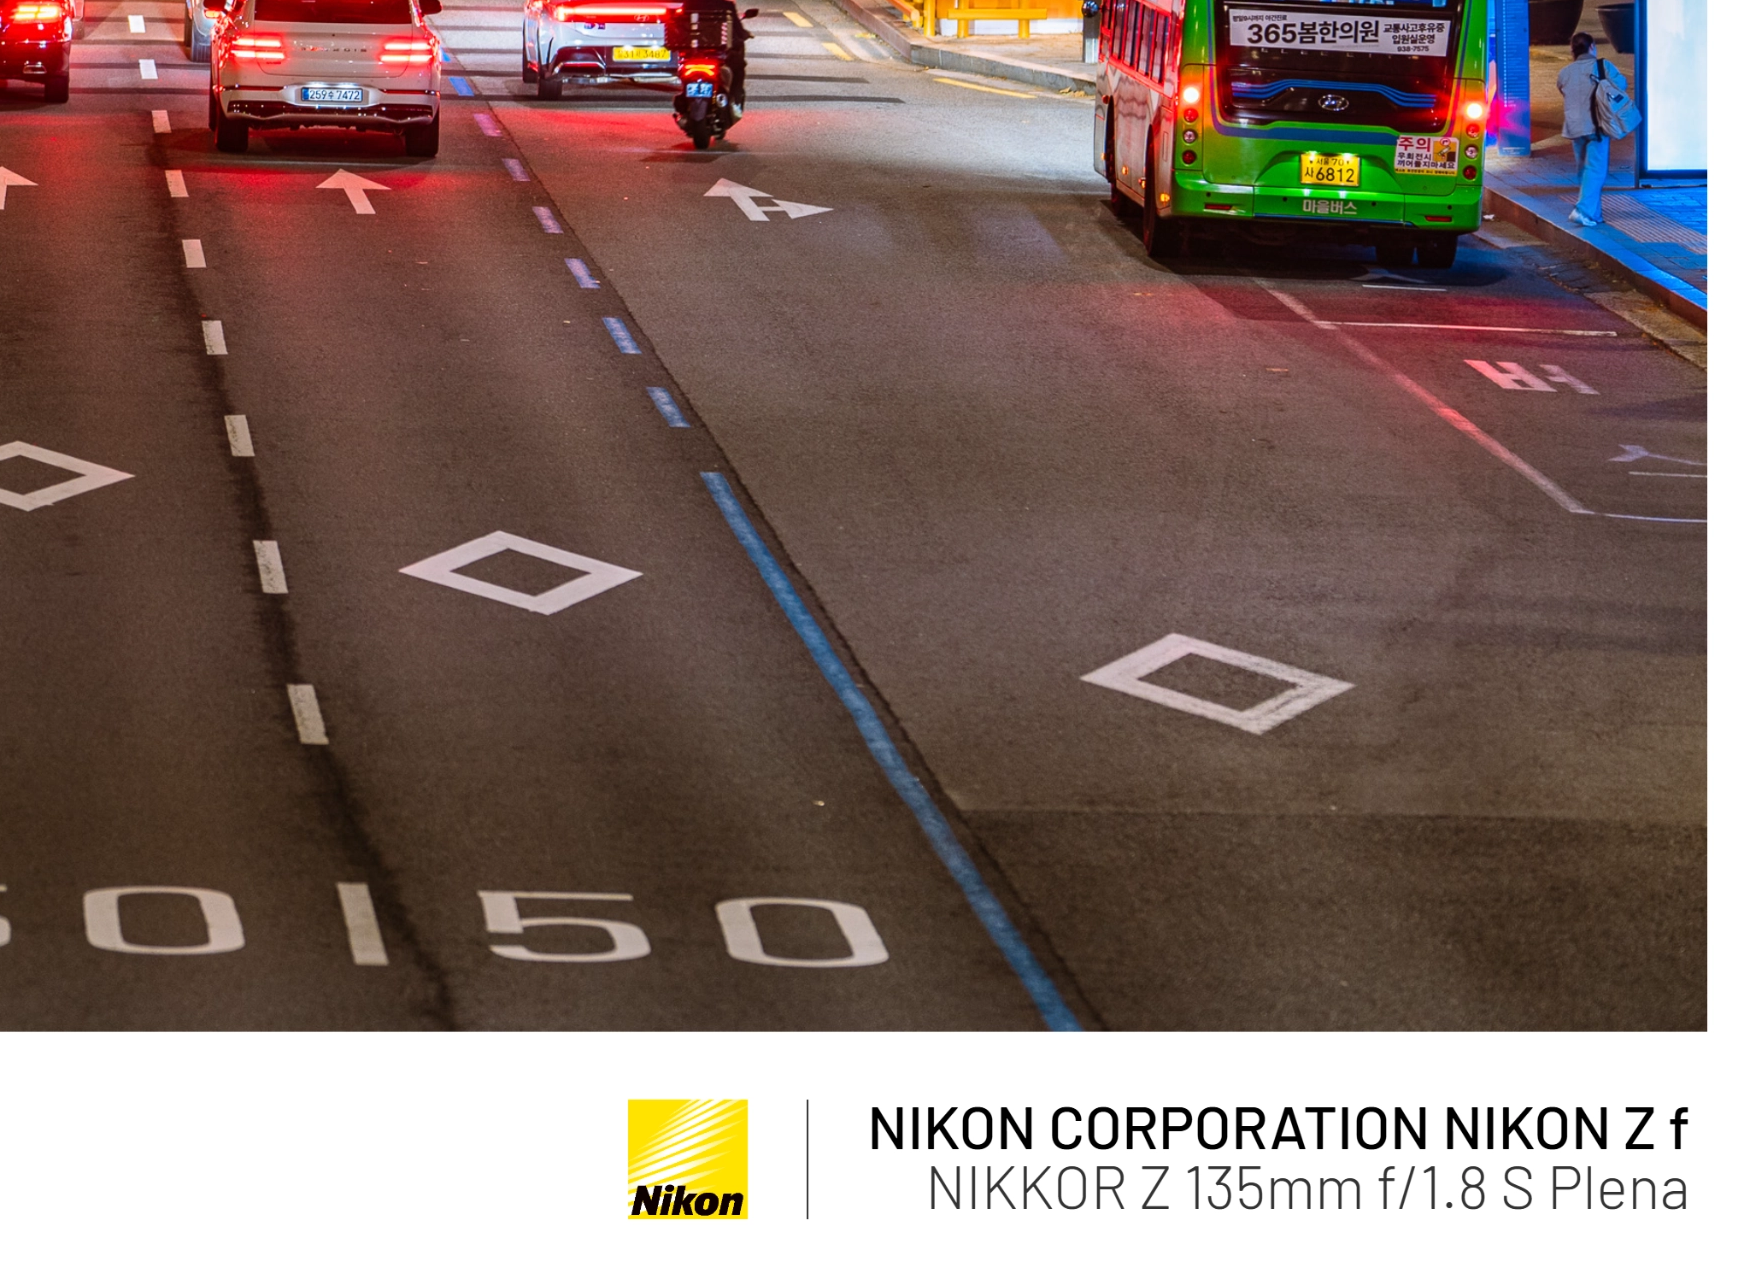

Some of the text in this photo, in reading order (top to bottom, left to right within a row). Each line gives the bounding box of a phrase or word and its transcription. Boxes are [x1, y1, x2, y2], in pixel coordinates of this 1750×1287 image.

[1247, 20, 1379, 45] 365봄한의원
[1383, 23, 1445, 33] 교통사고후유증
[1392, 34, 1436, 45] 입원실운영
[336, 91, 360, 100] 7472
[1398, 137, 1431, 152] 주의
[1397, 152, 1432, 161] 우회전시
[1397, 159, 1456, 169] 끼어들지마세요
[1303, 199, 1357, 215] 마을버스
[476, 888, 890, 969] 50
